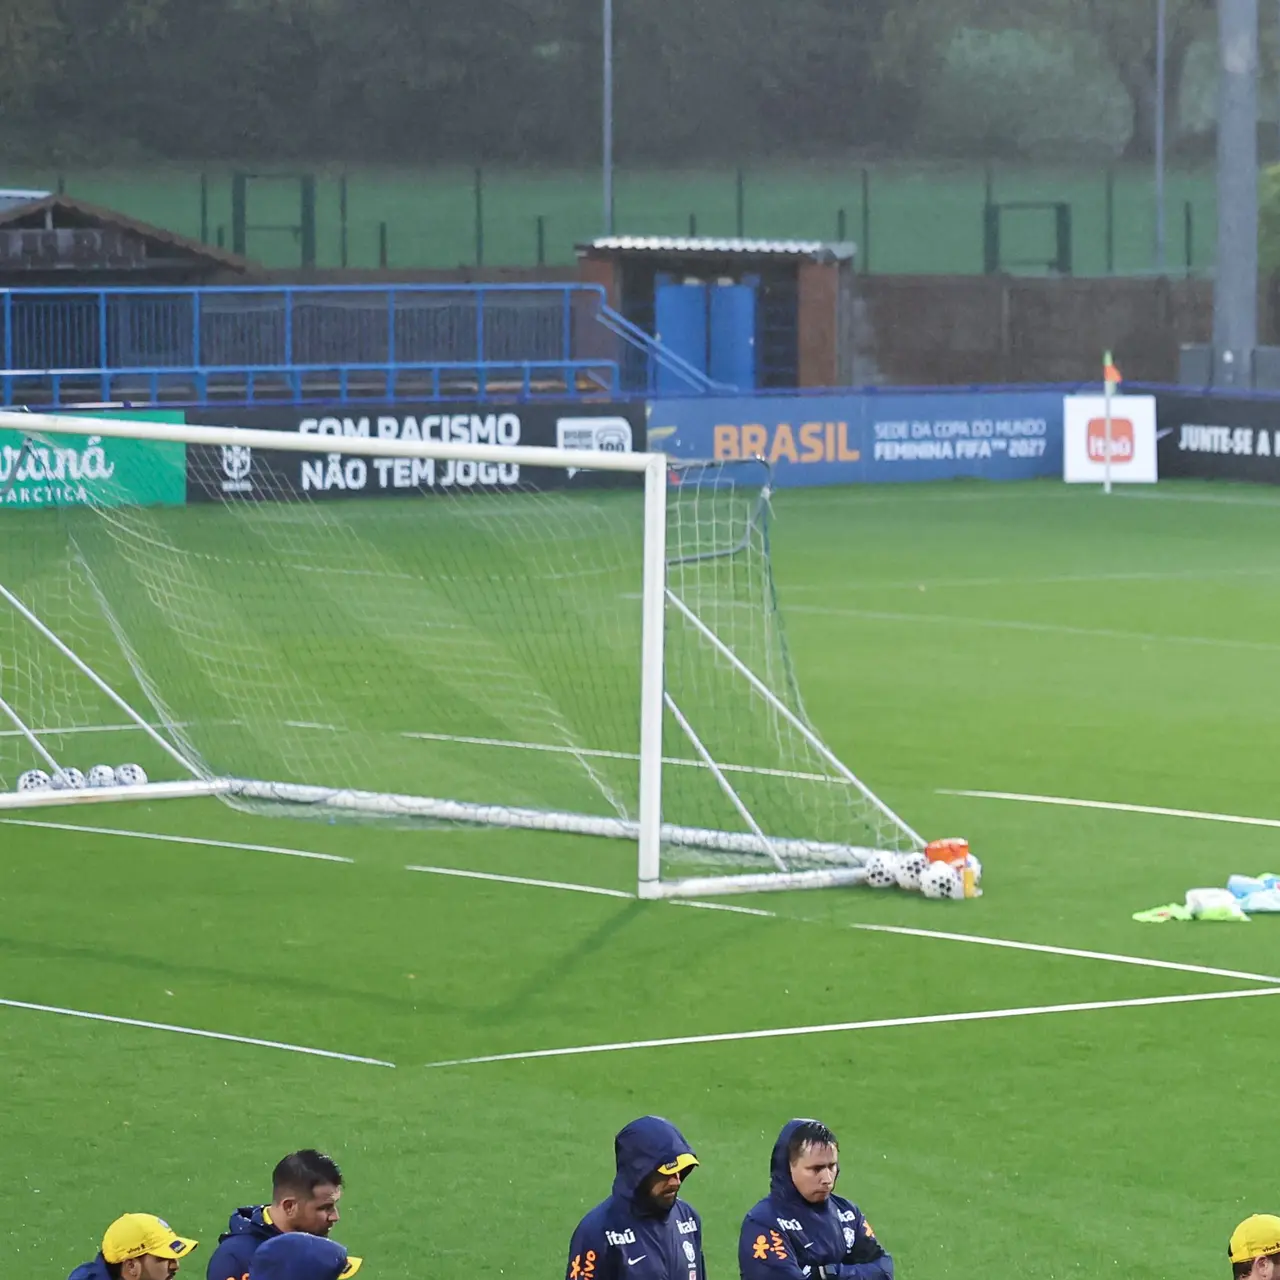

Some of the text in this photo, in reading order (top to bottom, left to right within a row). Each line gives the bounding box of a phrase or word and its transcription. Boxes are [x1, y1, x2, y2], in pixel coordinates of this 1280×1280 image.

[713, 421, 860, 464] BRASIL
[1179, 423, 1254, 456] JUNTE-SE
[1257, 430, 1271, 457] A
[301, 453, 367, 490] NÃO
[373, 458, 435, 488] TEM
[605, 1228, 636, 1246] itaú
